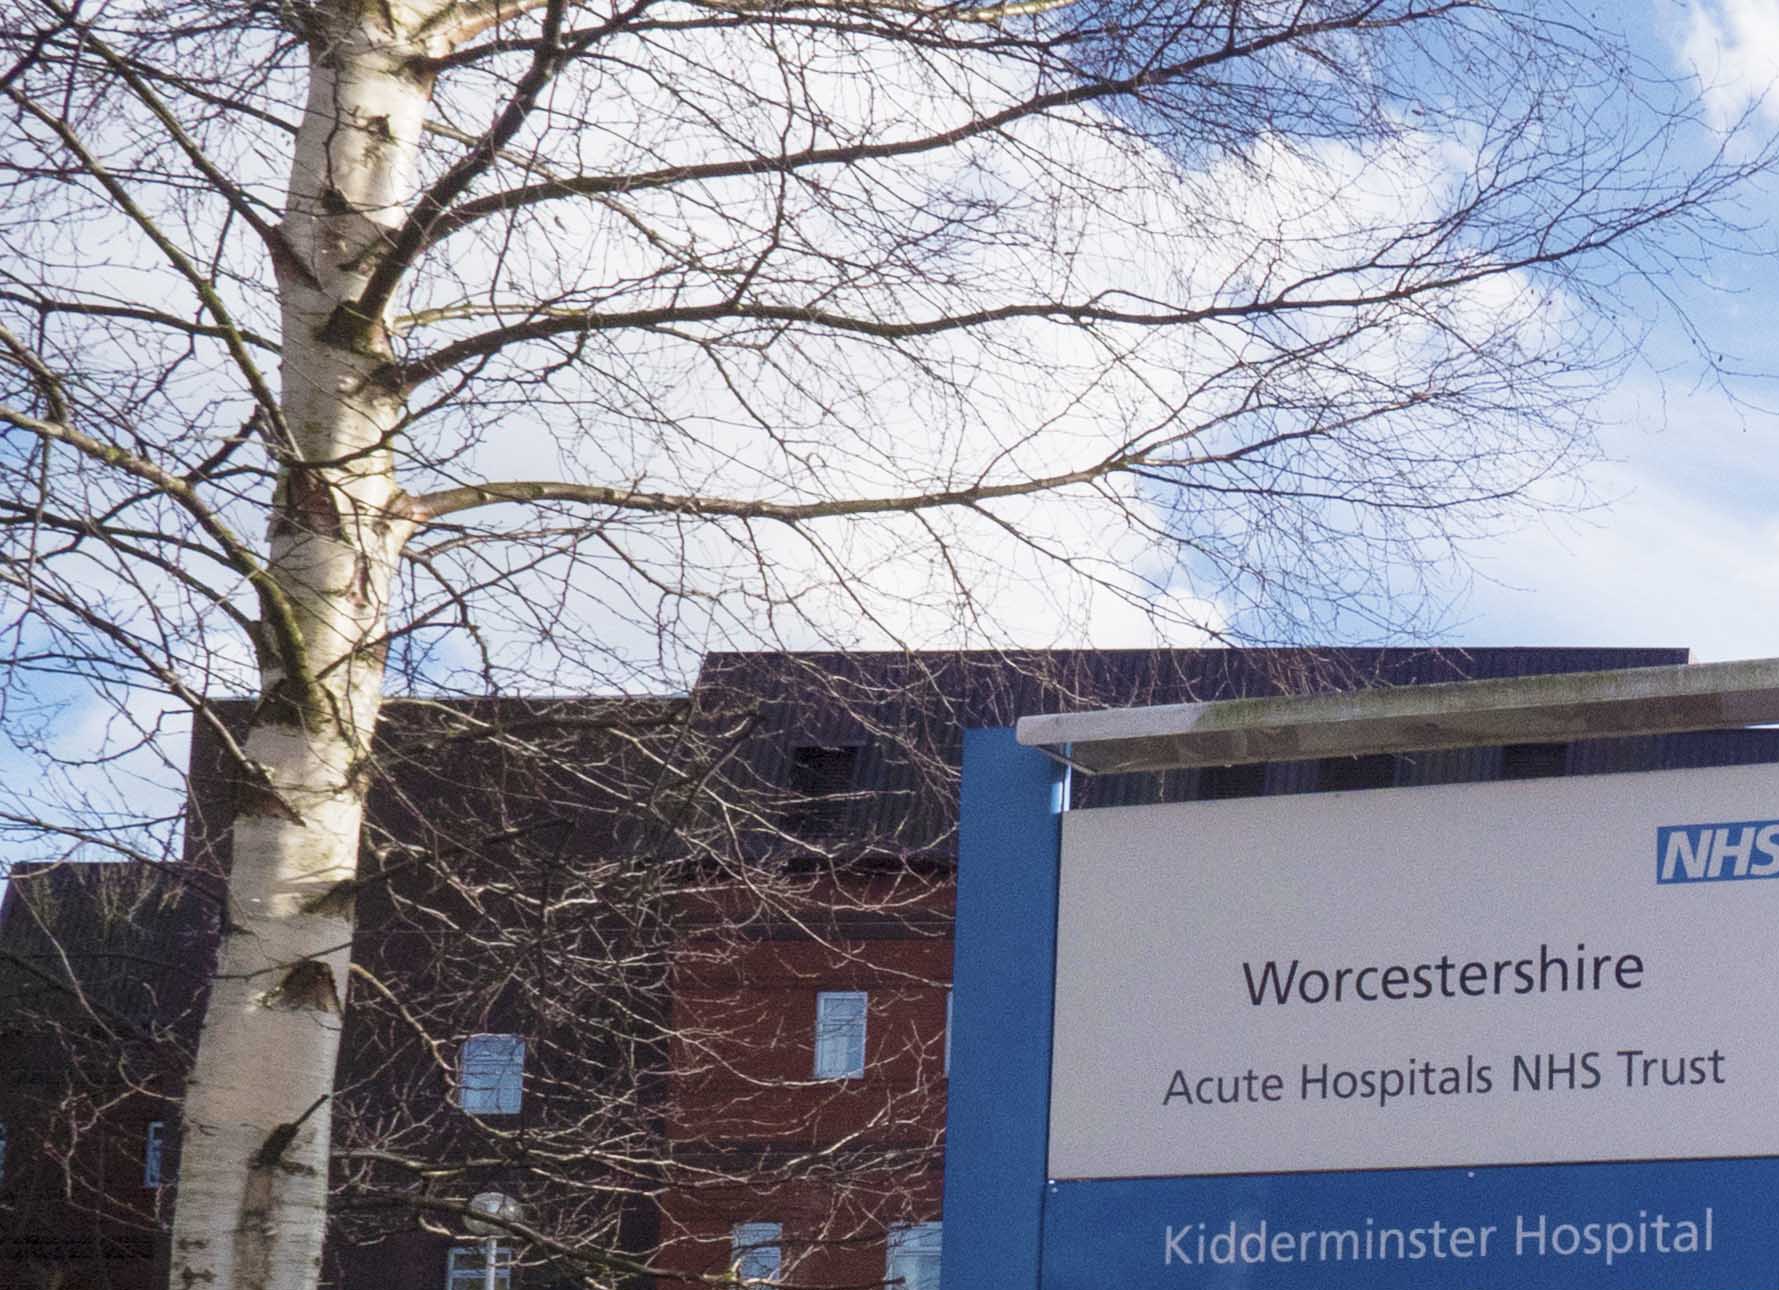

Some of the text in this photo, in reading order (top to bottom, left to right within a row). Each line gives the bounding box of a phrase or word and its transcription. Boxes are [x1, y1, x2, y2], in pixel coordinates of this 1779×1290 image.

[1243, 944, 1643, 1006] Worcestershire
[1163, 1050, 1725, 1107] Acute Hospitals NHS Trust
[1165, 1207, 1712, 1265] Kidderminster Hospital
